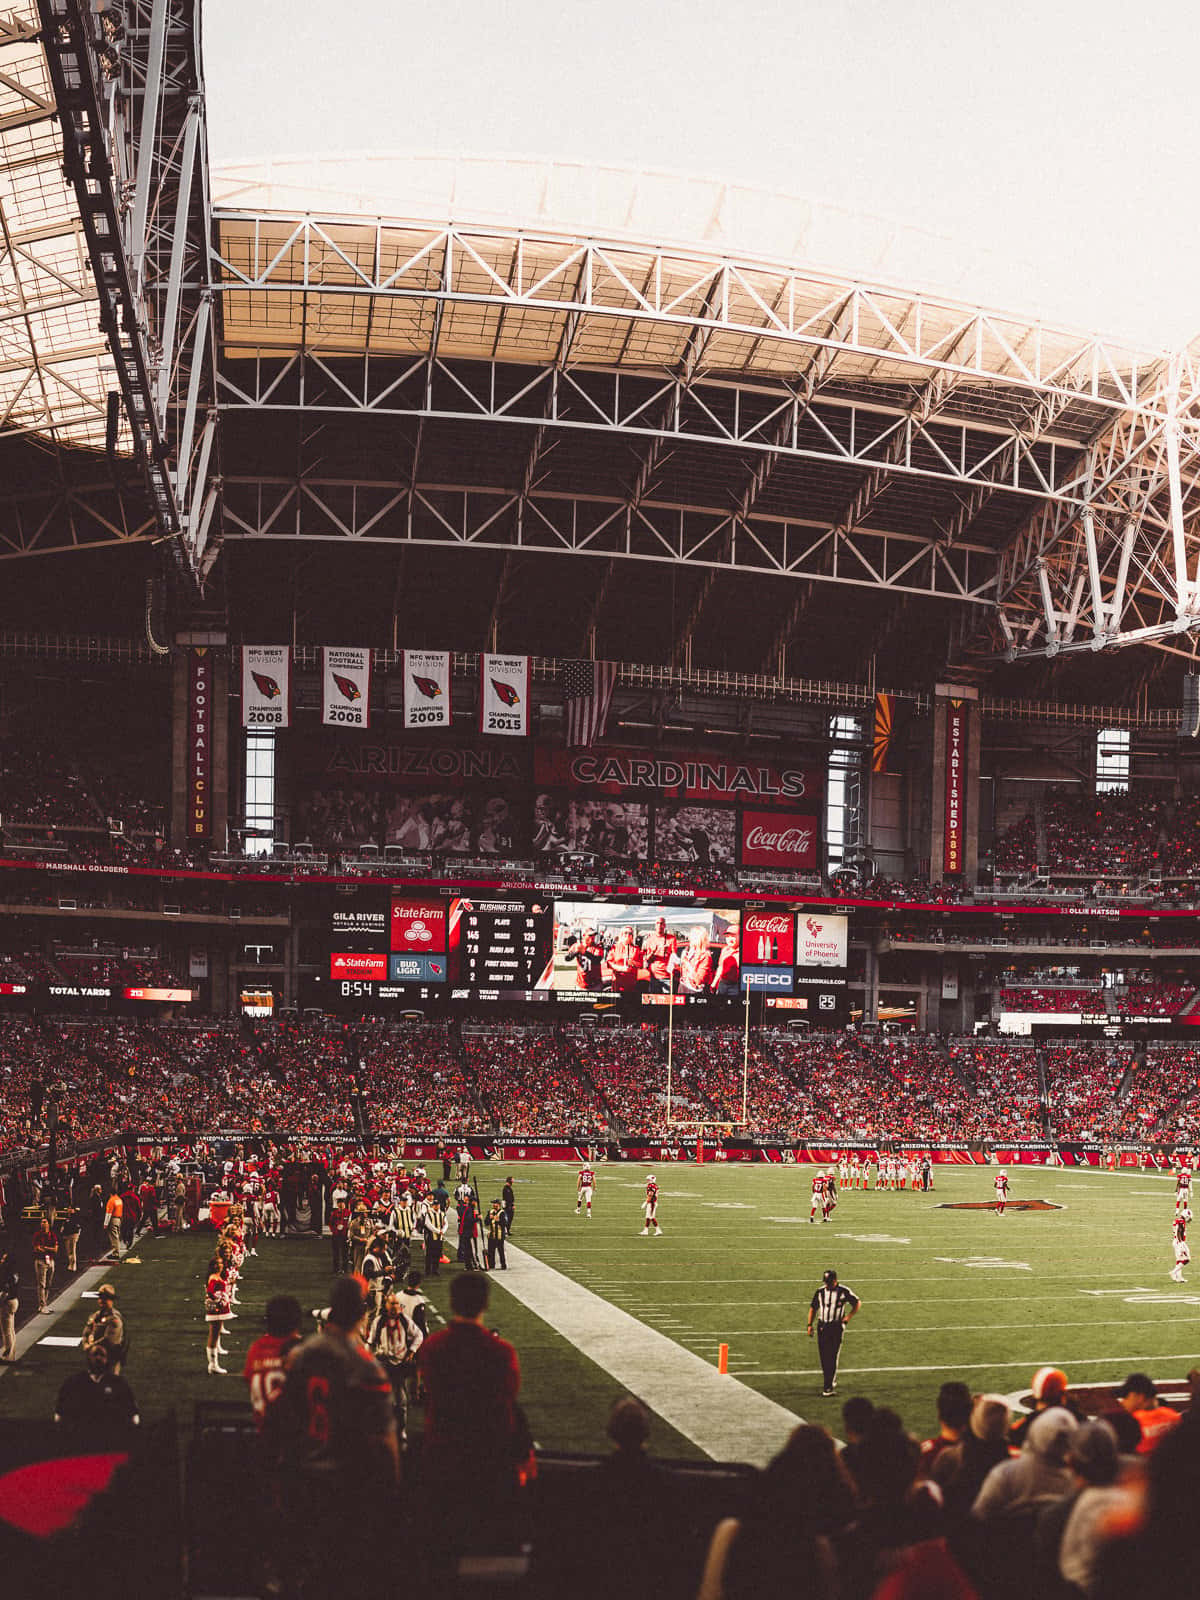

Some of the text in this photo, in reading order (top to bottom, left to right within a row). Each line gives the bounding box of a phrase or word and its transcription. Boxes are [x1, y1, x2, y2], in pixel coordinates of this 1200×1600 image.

[329, 651, 364, 659] NATIONAL
[329, 657, 364, 665] FOOTBALL
[489, 666, 523, 674] DIVISION
[330, 704, 362, 712] CHAMPIONS
[248, 712, 283, 723] 2008
[329, 711, 362, 723] 2008
[410, 713, 444, 723] 2009
[488, 718, 521, 730] 2015
[196, 667, 206, 833] FOOTBALL CLUB
[327, 745, 521, 777] ARIZONA
[571, 755, 805, 797] CARDINALS
[950, 717, 960, 829] ESTABLISHED
[746, 826, 813, 853] Coca-Cola
[46, 863, 87, 872] MARSHALL
[88, 864, 129, 874] GOLDBERG
[501, 881, 533, 889] ARIZONA
[534, 883, 578, 891] CARDINALS
[668, 889, 695, 897] HONOR
[480, 903, 525, 912] RUSHING STATS
[1090, 908, 1120, 916] MATSON
[333, 913, 385, 922] GILA RIVER
[746, 915, 790, 933] Coca-Cola
[805, 940, 838, 950] University
[523, 946, 536, 956] 7.2
[399, 960, 418, 968] BUD
[470, 972, 476, 981] 2
[742, 973, 792, 986] GEICO
[49, 987, 79, 995] TOTAL
[80, 988, 112, 996] YARDS
[341, 981, 372, 996] 8:54
[822, 997, 834, 1008] 25
[582, 1175, 592, 1183] 82
